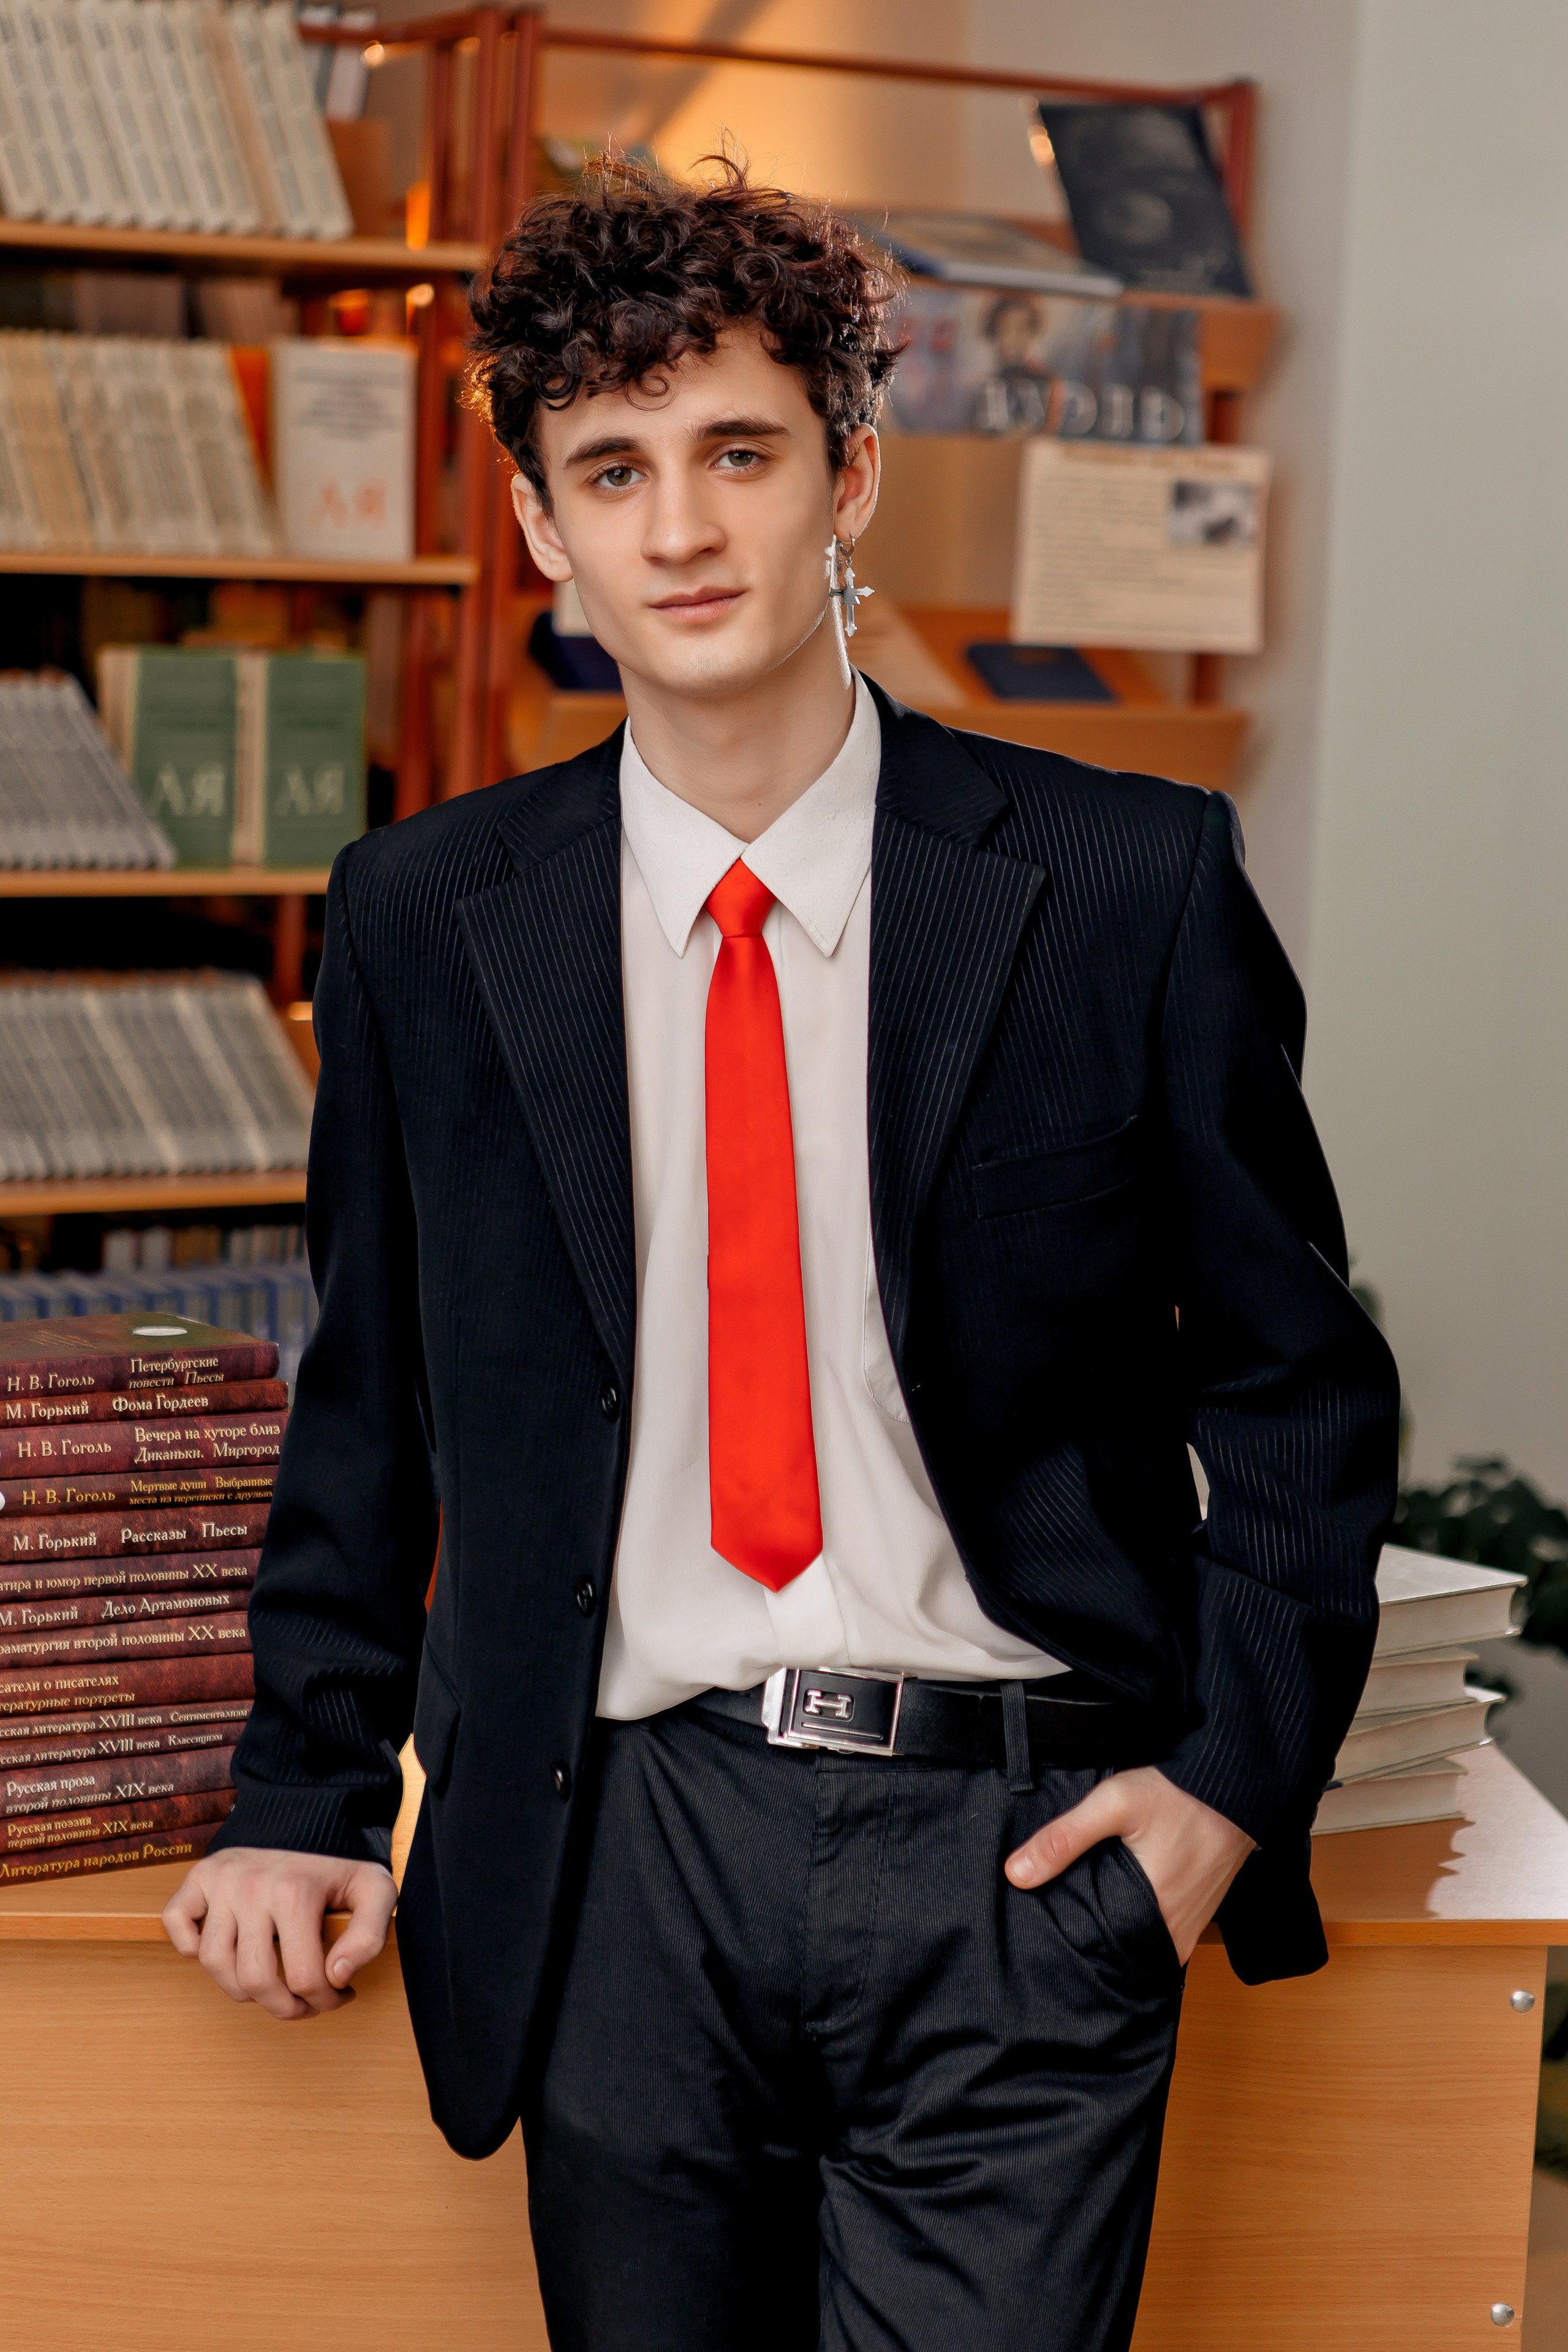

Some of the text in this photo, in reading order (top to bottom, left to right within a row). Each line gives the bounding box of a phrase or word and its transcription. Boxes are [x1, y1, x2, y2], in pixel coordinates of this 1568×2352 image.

[130, 1357, 219, 1373] Петербургские
[7, 1373, 94, 1392] Н. В. Гоголь
[129, 1371, 224, 1389] повести Пьесы
[6, 1400, 89, 1420] М. Горький
[113, 1392, 208, 1412] Фома Гордеев
[135, 1423, 281, 1444] Вечера на хуторе близ
[18, 1439, 111, 1457] Н. В. Гоголь
[134, 1442, 280, 1464] Диканьки. Миргород
[130, 1476, 273, 1493] Мертвые души Выбранные
[23, 1488, 116, 1505] Н. В. Гоголь
[174, 1493, 225, 1504] переписки
[13, 1532, 97, 1551] М. Горький
[121, 1521, 247, 1543] Рассказы Пьесы
[35, 1579, 43, 1589] и
[46, 1577, 80, 1589] юмор
[84, 1570, 126, 1587] первой
[129, 1570, 189, 1583] половины
[221, 1566, 247, 1577] века
[21, 1605, 78, 1626] Горький
[101, 1594, 230, 1619] Дело Артамоновых
[74, 1634, 118, 1650] второй
[121, 1632, 184, 1646] половины
[217, 1627, 246, 1639] века
[43, 1680, 51, 1690] о
[55, 1676, 119, 1689] писателях
[74, 1693, 135, 1707] портреты
[32, 1721, 96, 1734] литература
[137, 1716, 162, 1726] века
[170, 1709, 247, 1722] Сентиментализм
[34, 1747, 96, 1761] литература
[135, 1741, 160, 1751] века
[167, 1733, 223, 1746] Классицизм
[6, 1776, 96, 1798] Русская проза
[6, 1796, 48, 1814] второй
[52, 1792, 111, 1807] половины
[148, 1783, 174, 1795] века
[7, 1816, 92, 1838] Русская поэзия
[7, 1833, 45, 1849] первой
[47, 1828, 100, 1842] половины
[130, 1820, 153, 1831] века
[0, 1843, 192, 1878] Литература народов России
